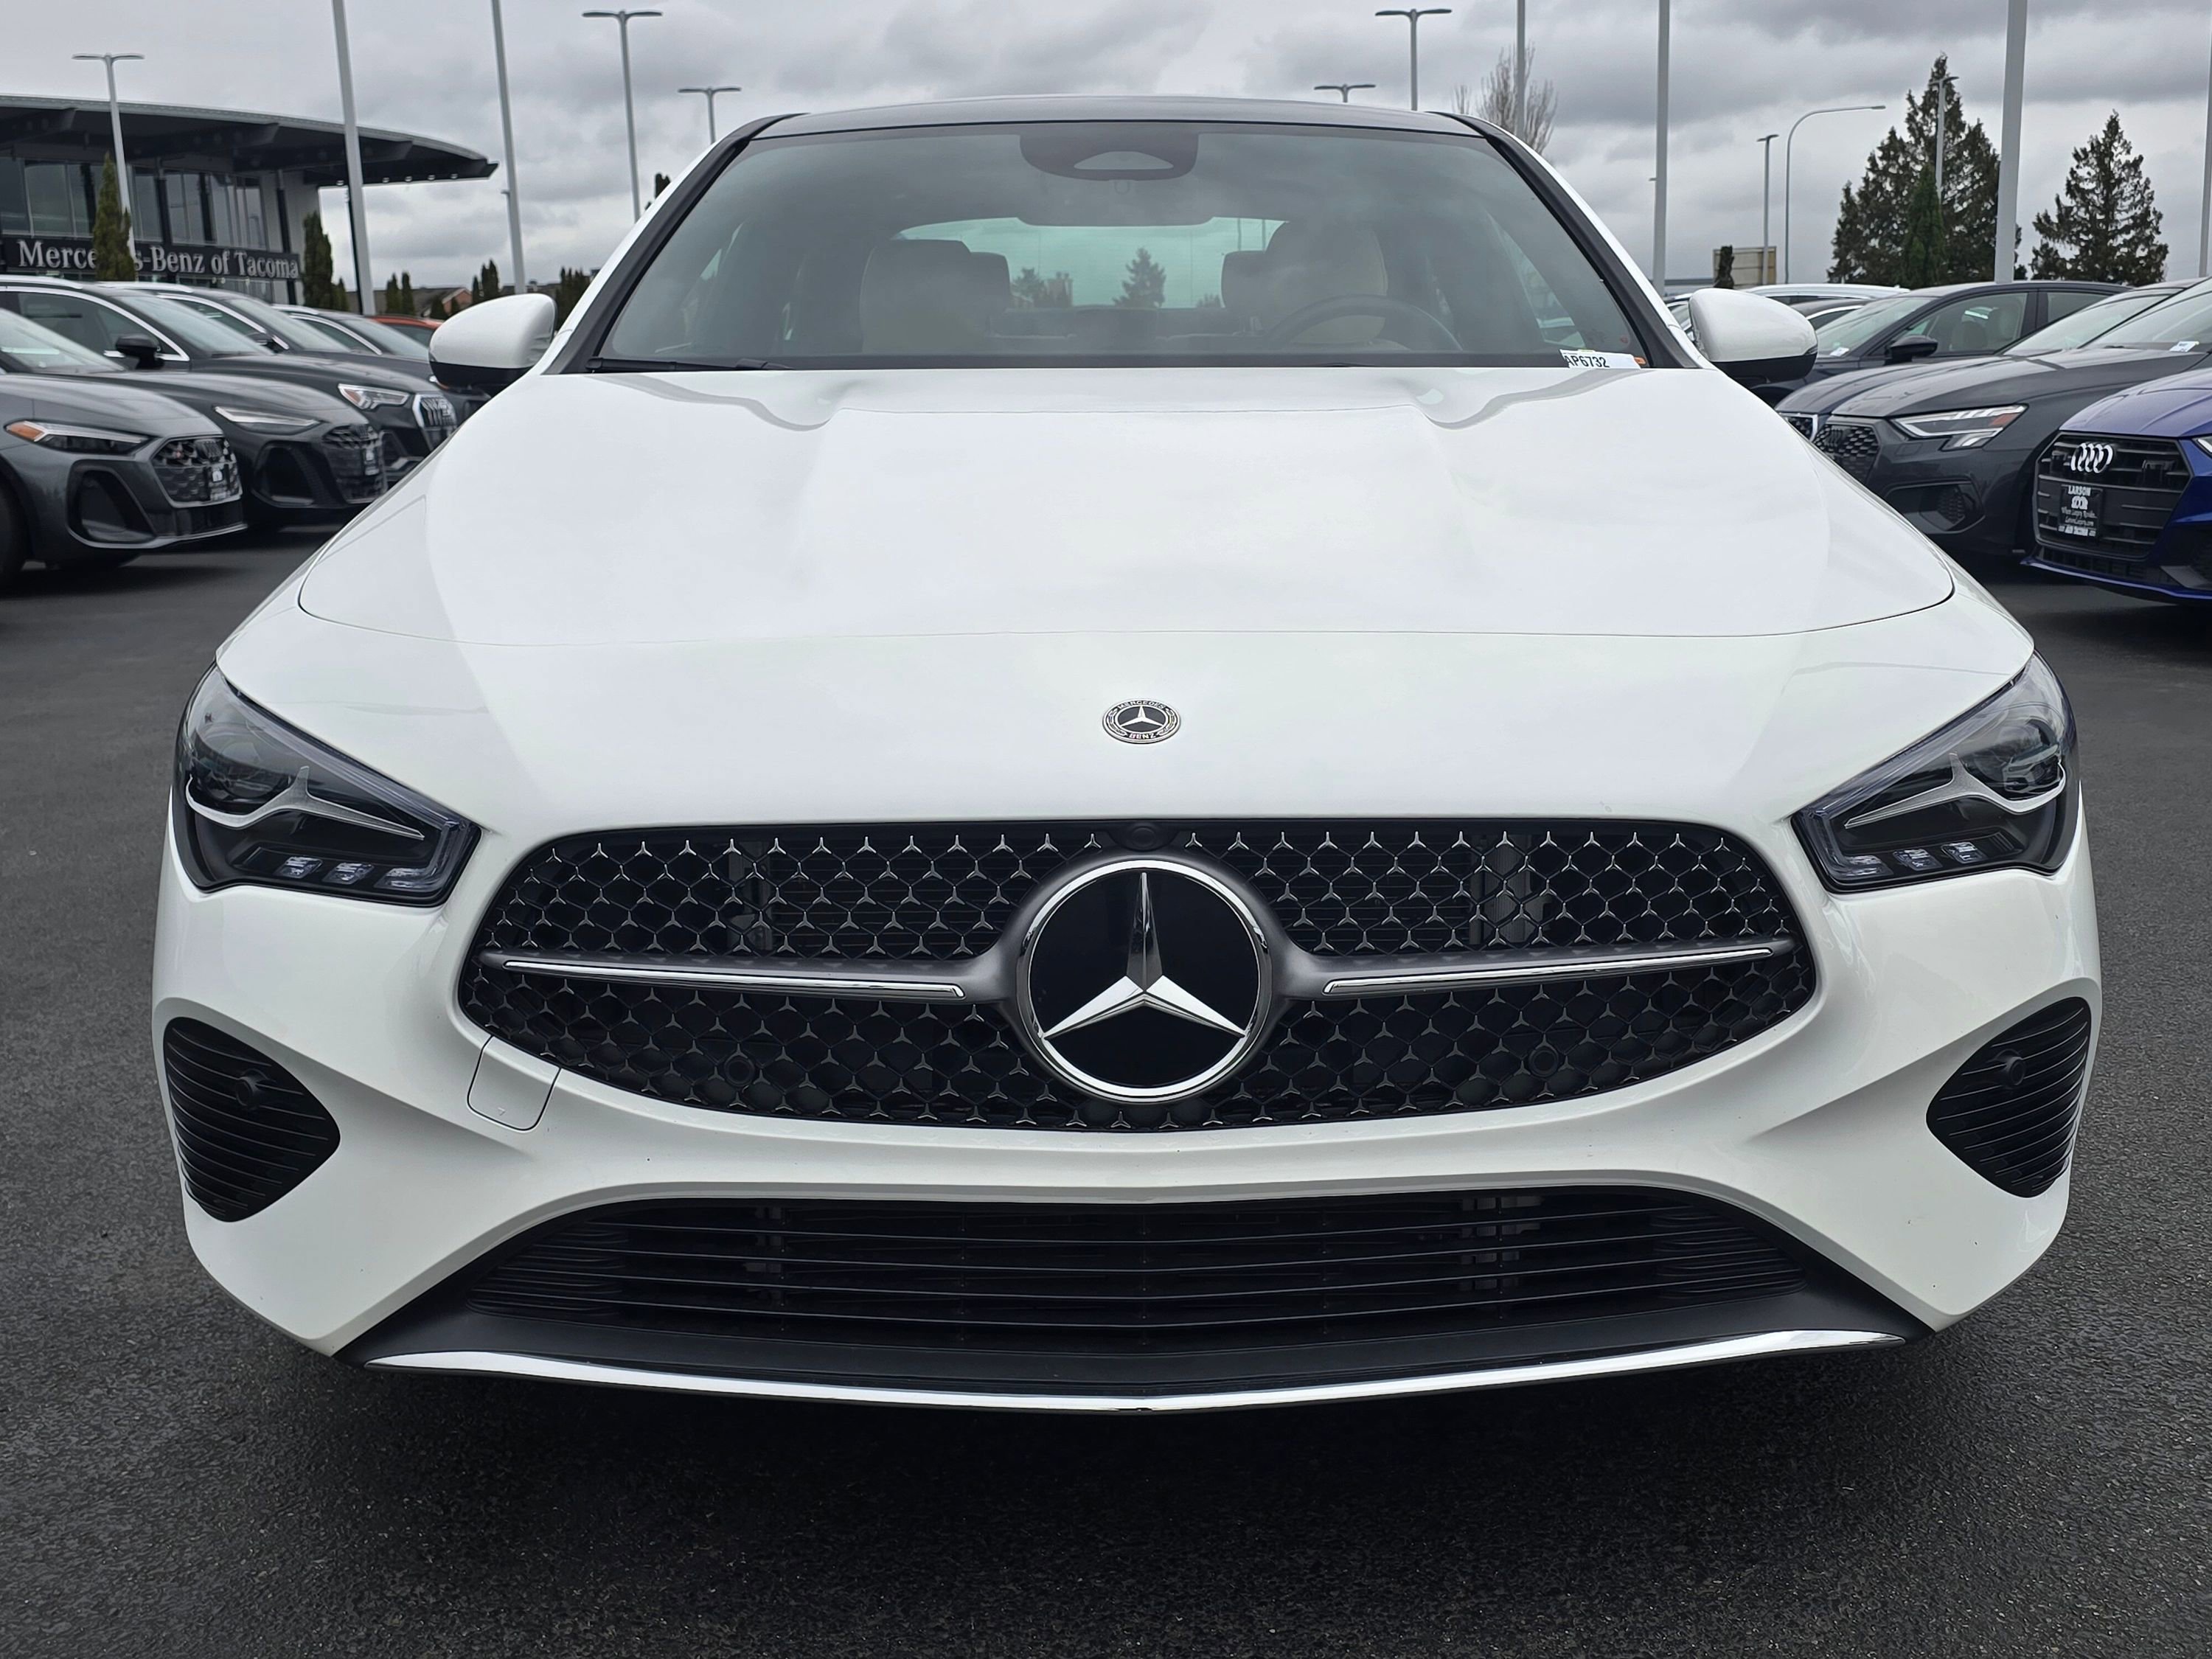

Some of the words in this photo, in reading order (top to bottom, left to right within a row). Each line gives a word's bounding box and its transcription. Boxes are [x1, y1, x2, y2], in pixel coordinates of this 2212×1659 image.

[18, 240, 205, 274] Merces-Benz
[210, 249, 230, 275] of
[234, 251, 299, 279] Tacoma
[1116, 700, 1166, 709] MERCEDES
